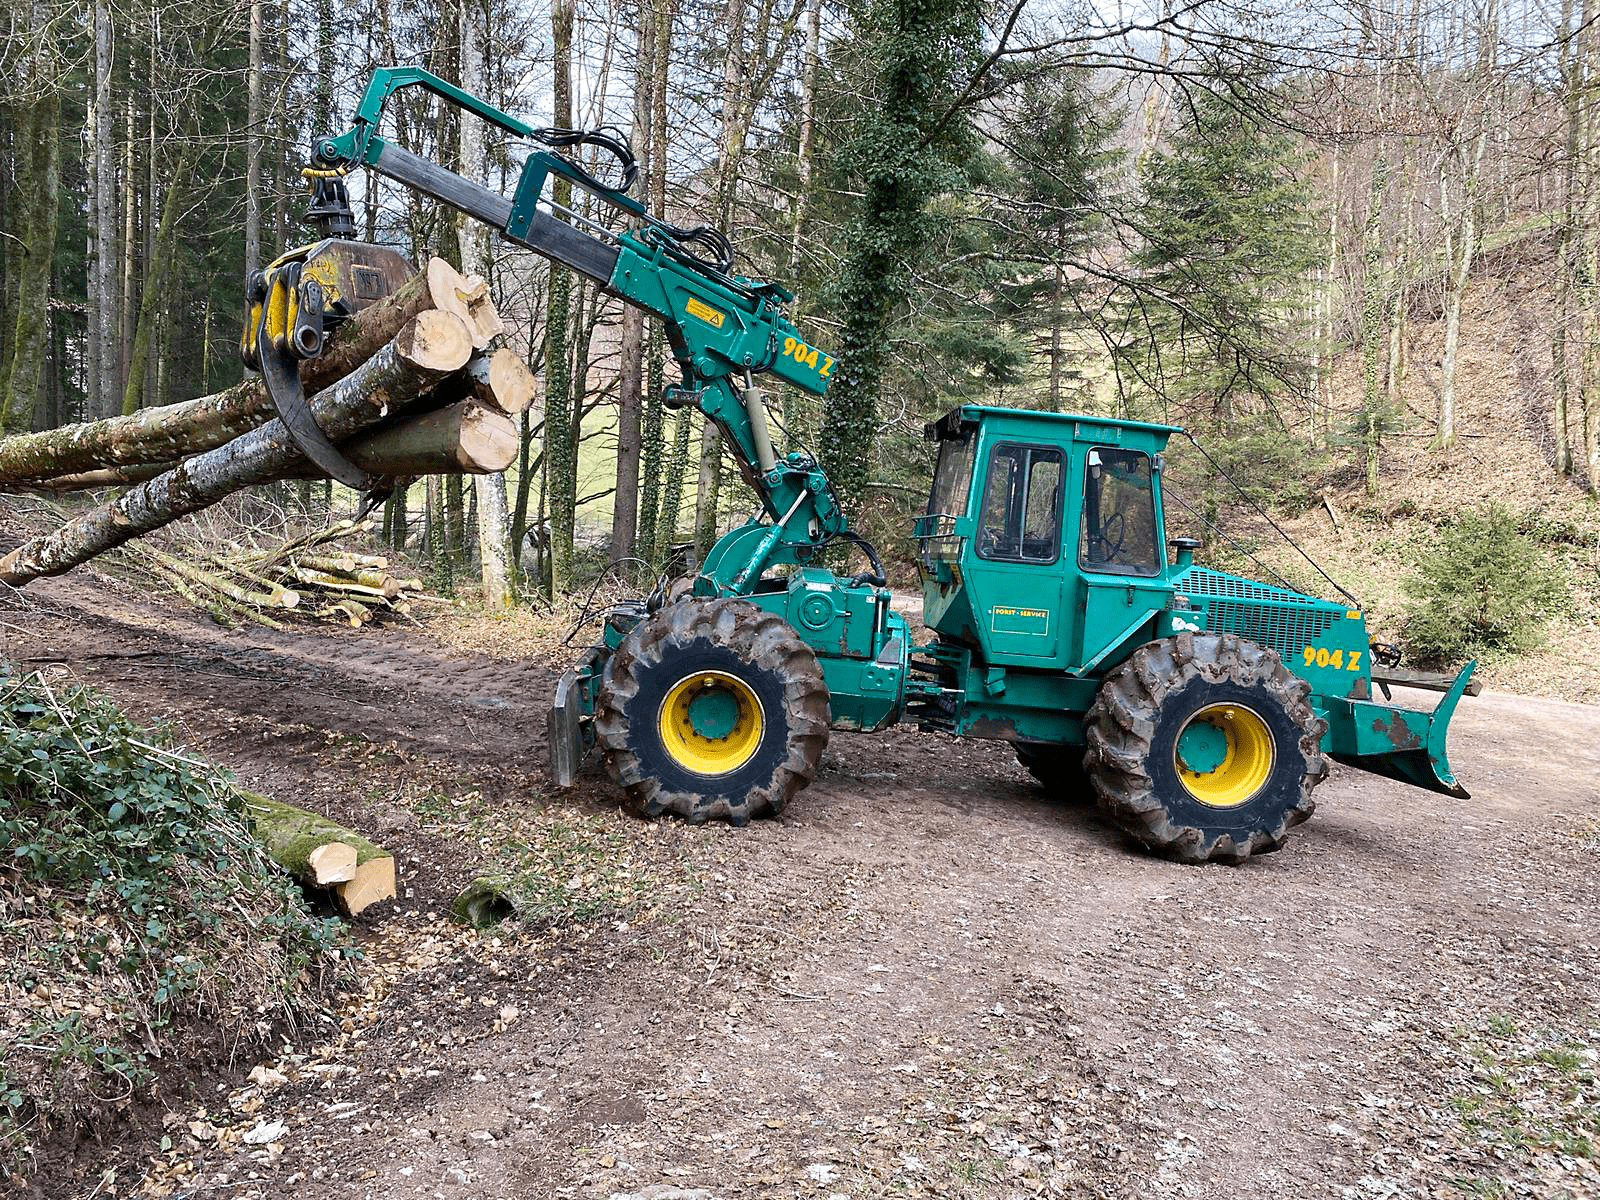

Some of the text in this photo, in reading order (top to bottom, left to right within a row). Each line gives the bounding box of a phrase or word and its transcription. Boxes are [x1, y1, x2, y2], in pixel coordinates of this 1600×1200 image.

[783, 337, 835, 377] 904 Z
[1303, 647, 1362, 671] 904 Z
